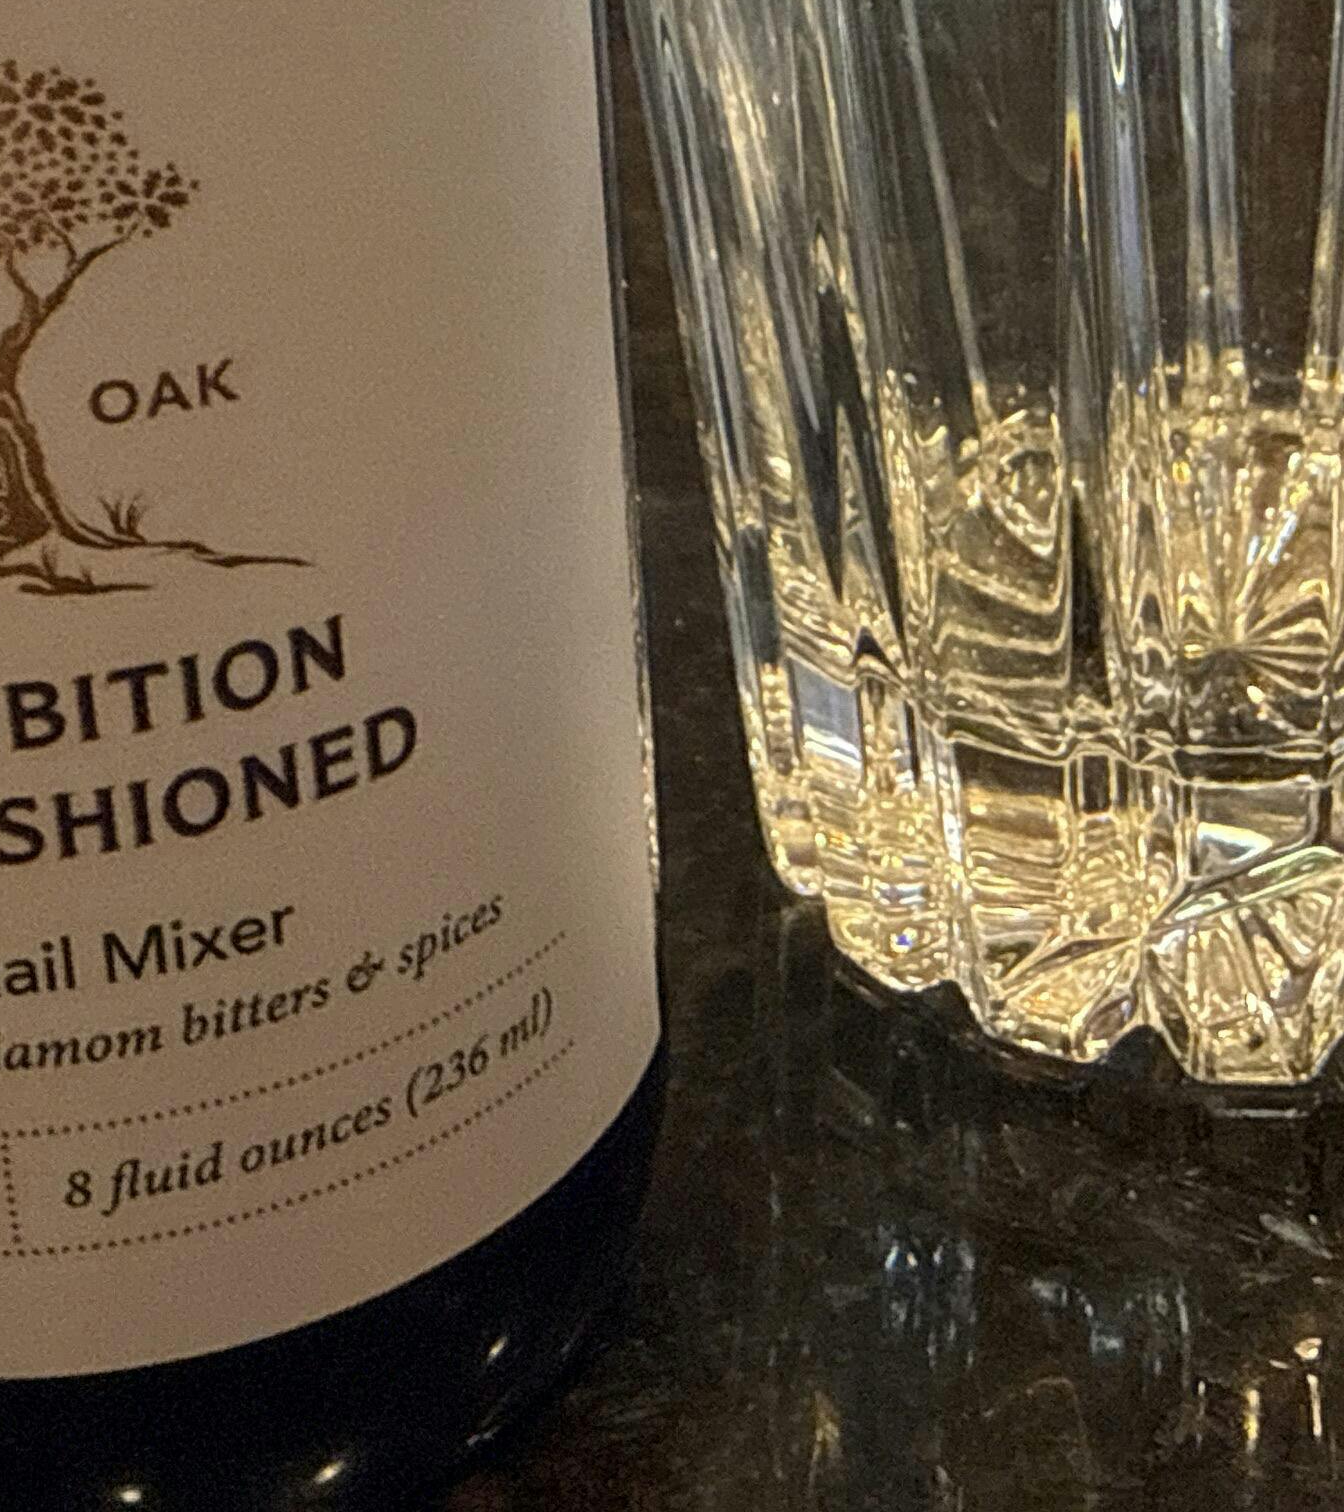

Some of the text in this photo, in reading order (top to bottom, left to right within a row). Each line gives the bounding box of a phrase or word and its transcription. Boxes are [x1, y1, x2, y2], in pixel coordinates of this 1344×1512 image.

[88, 358, 241, 425] OAK
[103, 904, 295, 983] Mixer
[182, 978, 330, 1046] bitters
[346, 951, 385, 994] &
[396, 895, 504, 981] spices
[64, 987, 553, 1217] 8 fluid ounces (236 ml)
